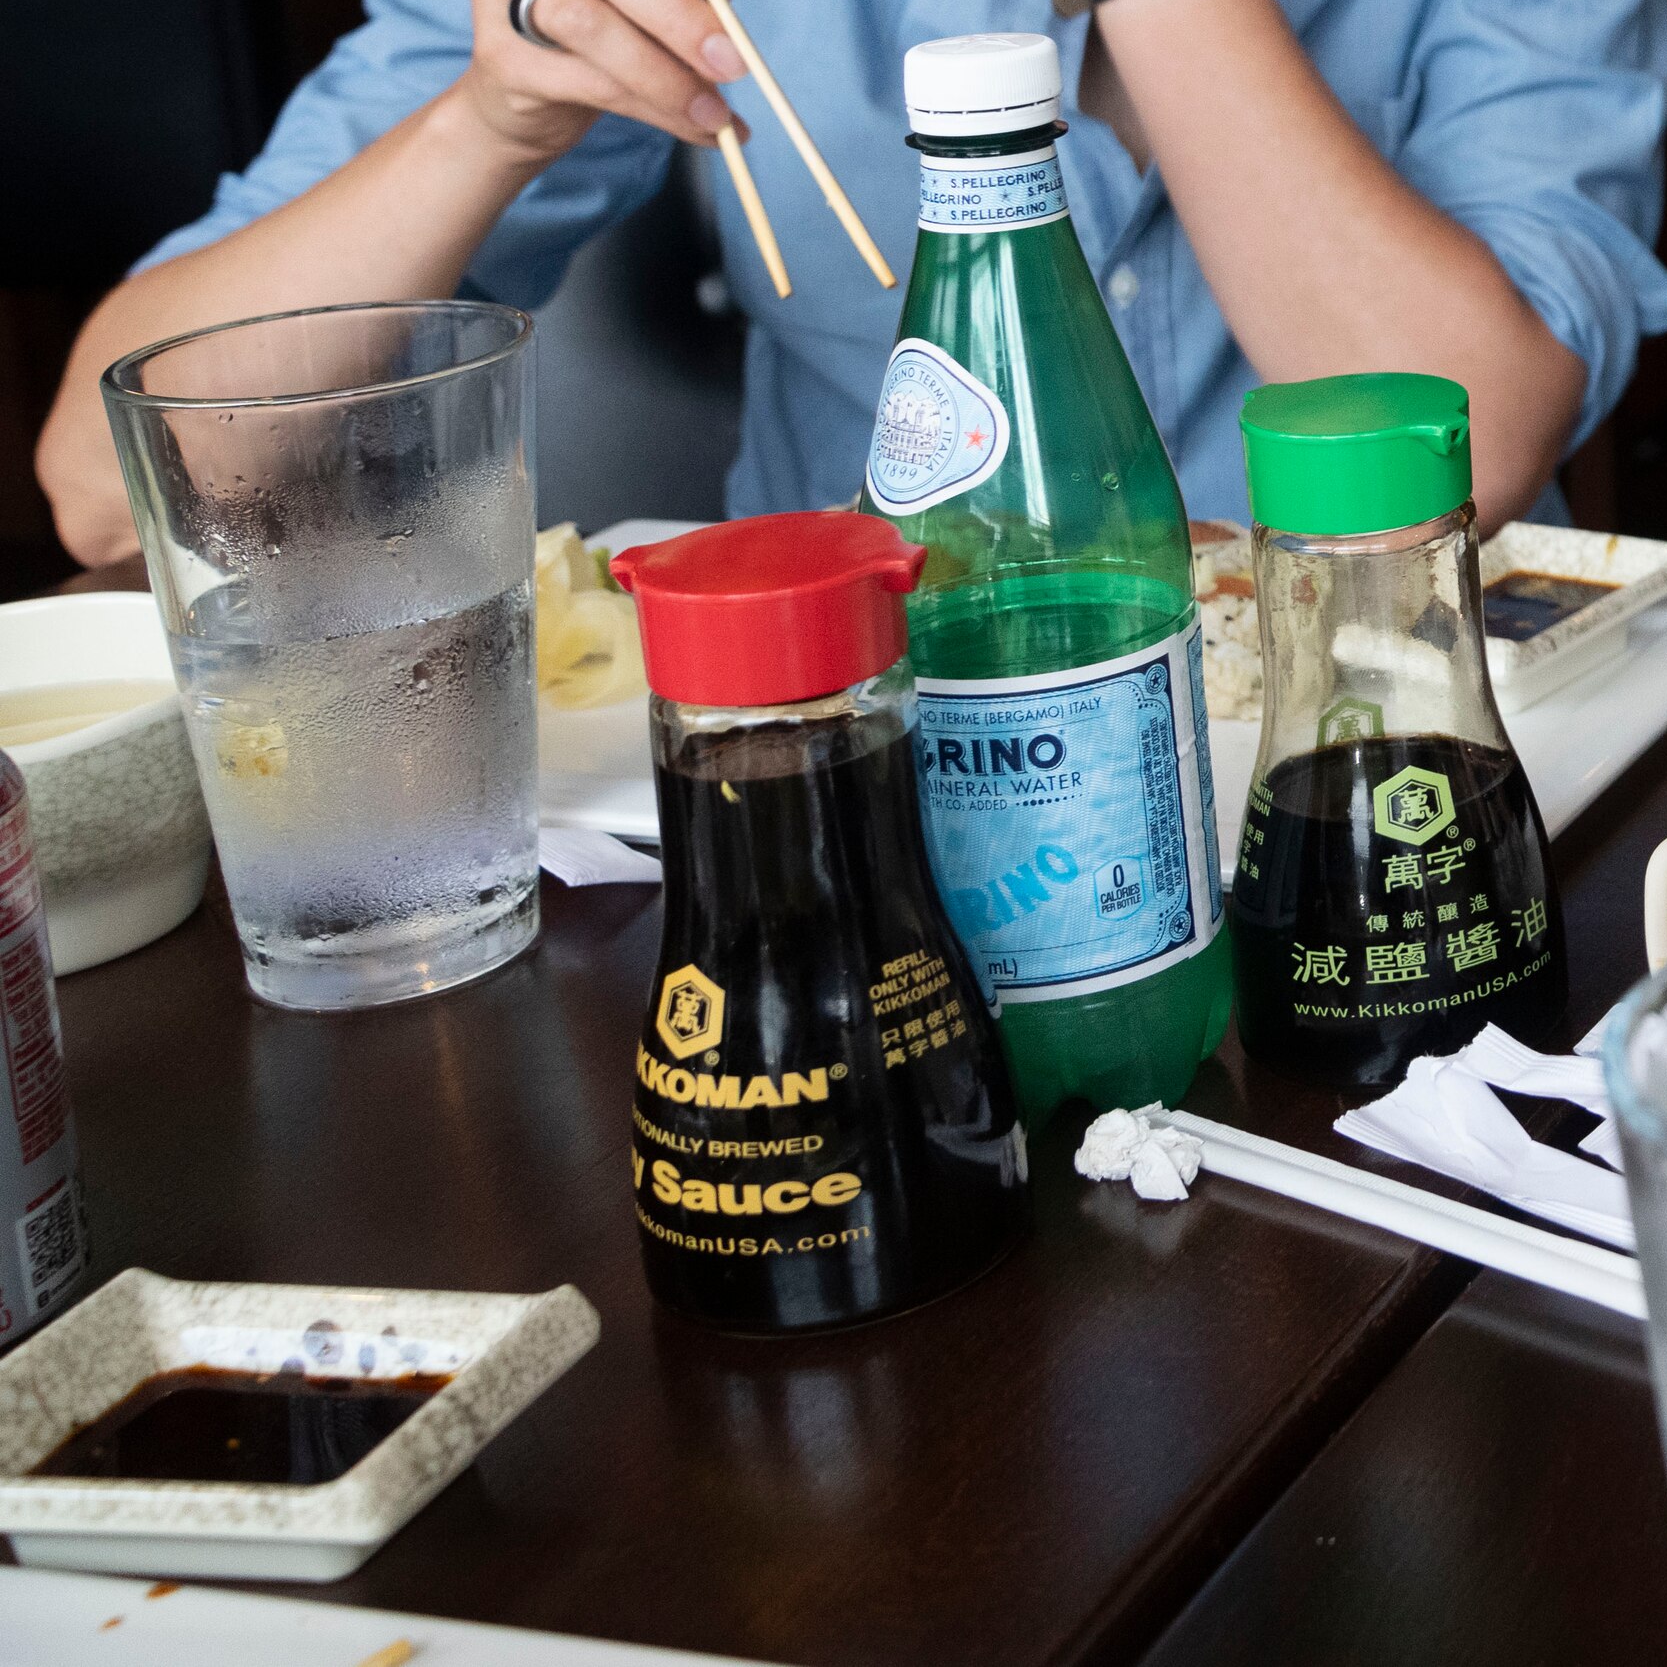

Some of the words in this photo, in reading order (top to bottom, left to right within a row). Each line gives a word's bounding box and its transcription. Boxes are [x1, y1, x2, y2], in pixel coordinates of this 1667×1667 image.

[919, 370, 950, 409] TERME
[925, 431, 953, 472] ITALIA
[883, 462, 918, 480] 1899
[942, 711, 980, 725] TERME
[984, 705, 1064, 727] (BERGAMO)
[1069, 697, 1102, 714] ITALY
[1010, 772, 1083, 795] WATER
[969, 798, 1008, 811] ADDED
[1382, 845, 1467, 894] 萬字
[1099, 884, 1141, 905] CALORIES
[1101, 900, 1116, 914] PER
[1116, 893, 1142, 911] BOTTLE
[1291, 897, 1549, 986] 減鹽醬油
[869, 973, 911, 1001] ONLY
[911, 956, 946, 983] WITH
[881, 949, 931, 979] REFILL
[872, 971, 951, 1017] KIKKOMAN
[1294, 950, 1551, 1019] www.KikkomanUSA.com
[708, 1134, 824, 1159] BREWED
[651, 1159, 863, 1215] Sauce
